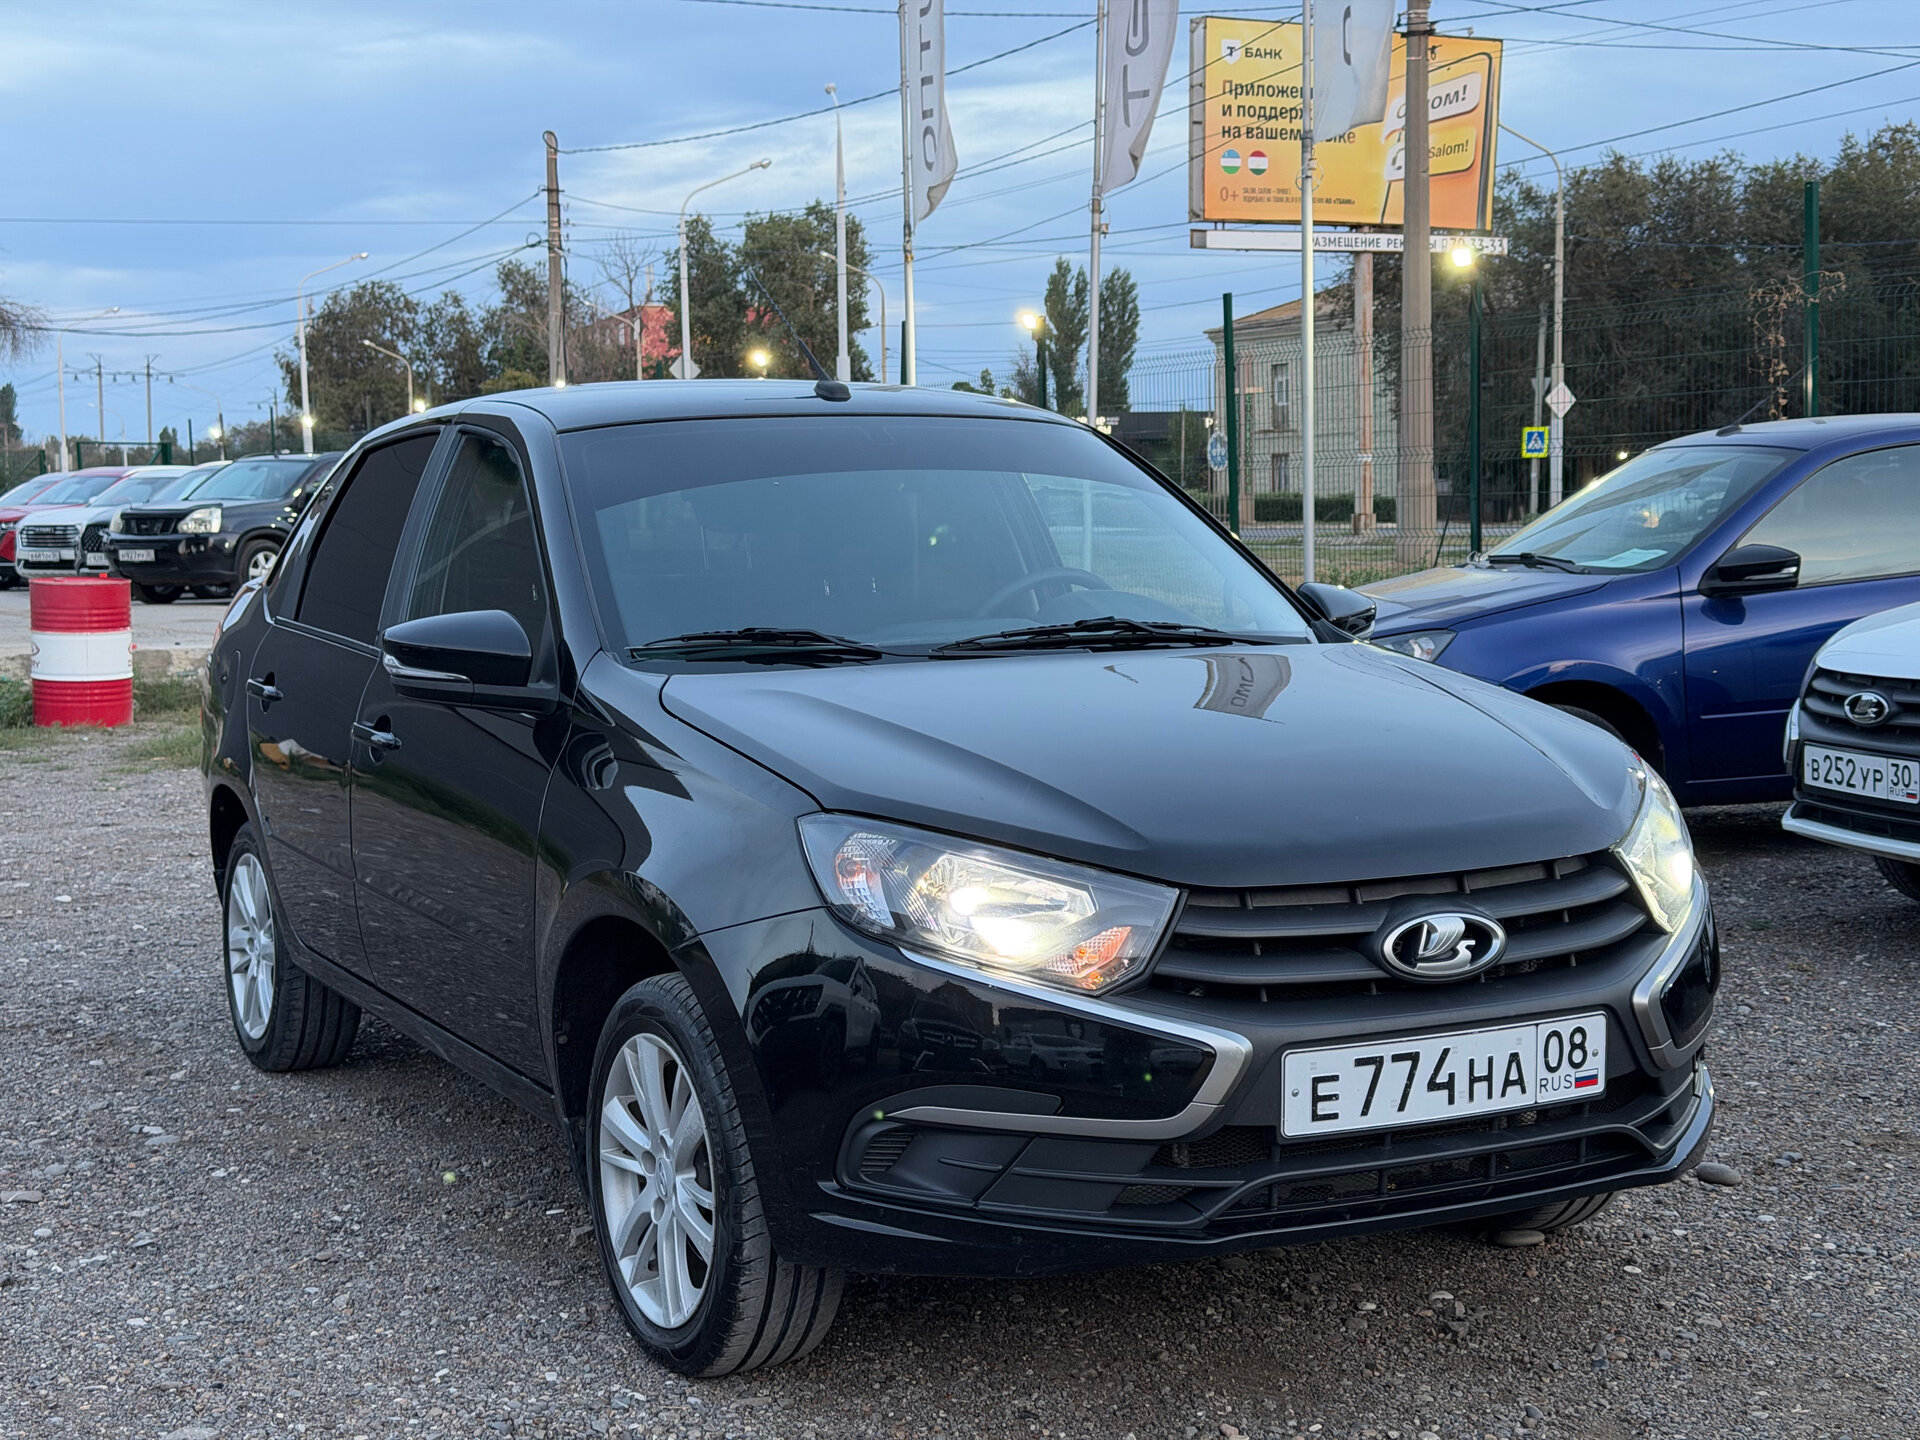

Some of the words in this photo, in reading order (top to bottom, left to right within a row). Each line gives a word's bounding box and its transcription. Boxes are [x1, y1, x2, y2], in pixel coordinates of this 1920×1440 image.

[1244, 47, 1283, 60] БАНК
[1222, 104, 1232, 117] и
[1236, 105, 1303, 123] поддер
[1222, 125, 1242, 139] на
[1245, 126, 1302, 141] вашем
[1429, 138, 1469, 159] Salom!
[1220, 186, 1239, 202] 0+
[1312, 236, 1381, 248] АЗМЕЩЕНИЕ
[1811, 754, 1884, 792] В252УР
[1890, 763, 1912, 788] 30
[1889, 786, 1906, 797] RUS
[1311, 1047, 1527, 1122] Е774НА
[1543, 1025, 1588, 1074] 08
[1539, 1073, 1573, 1094] RUS
